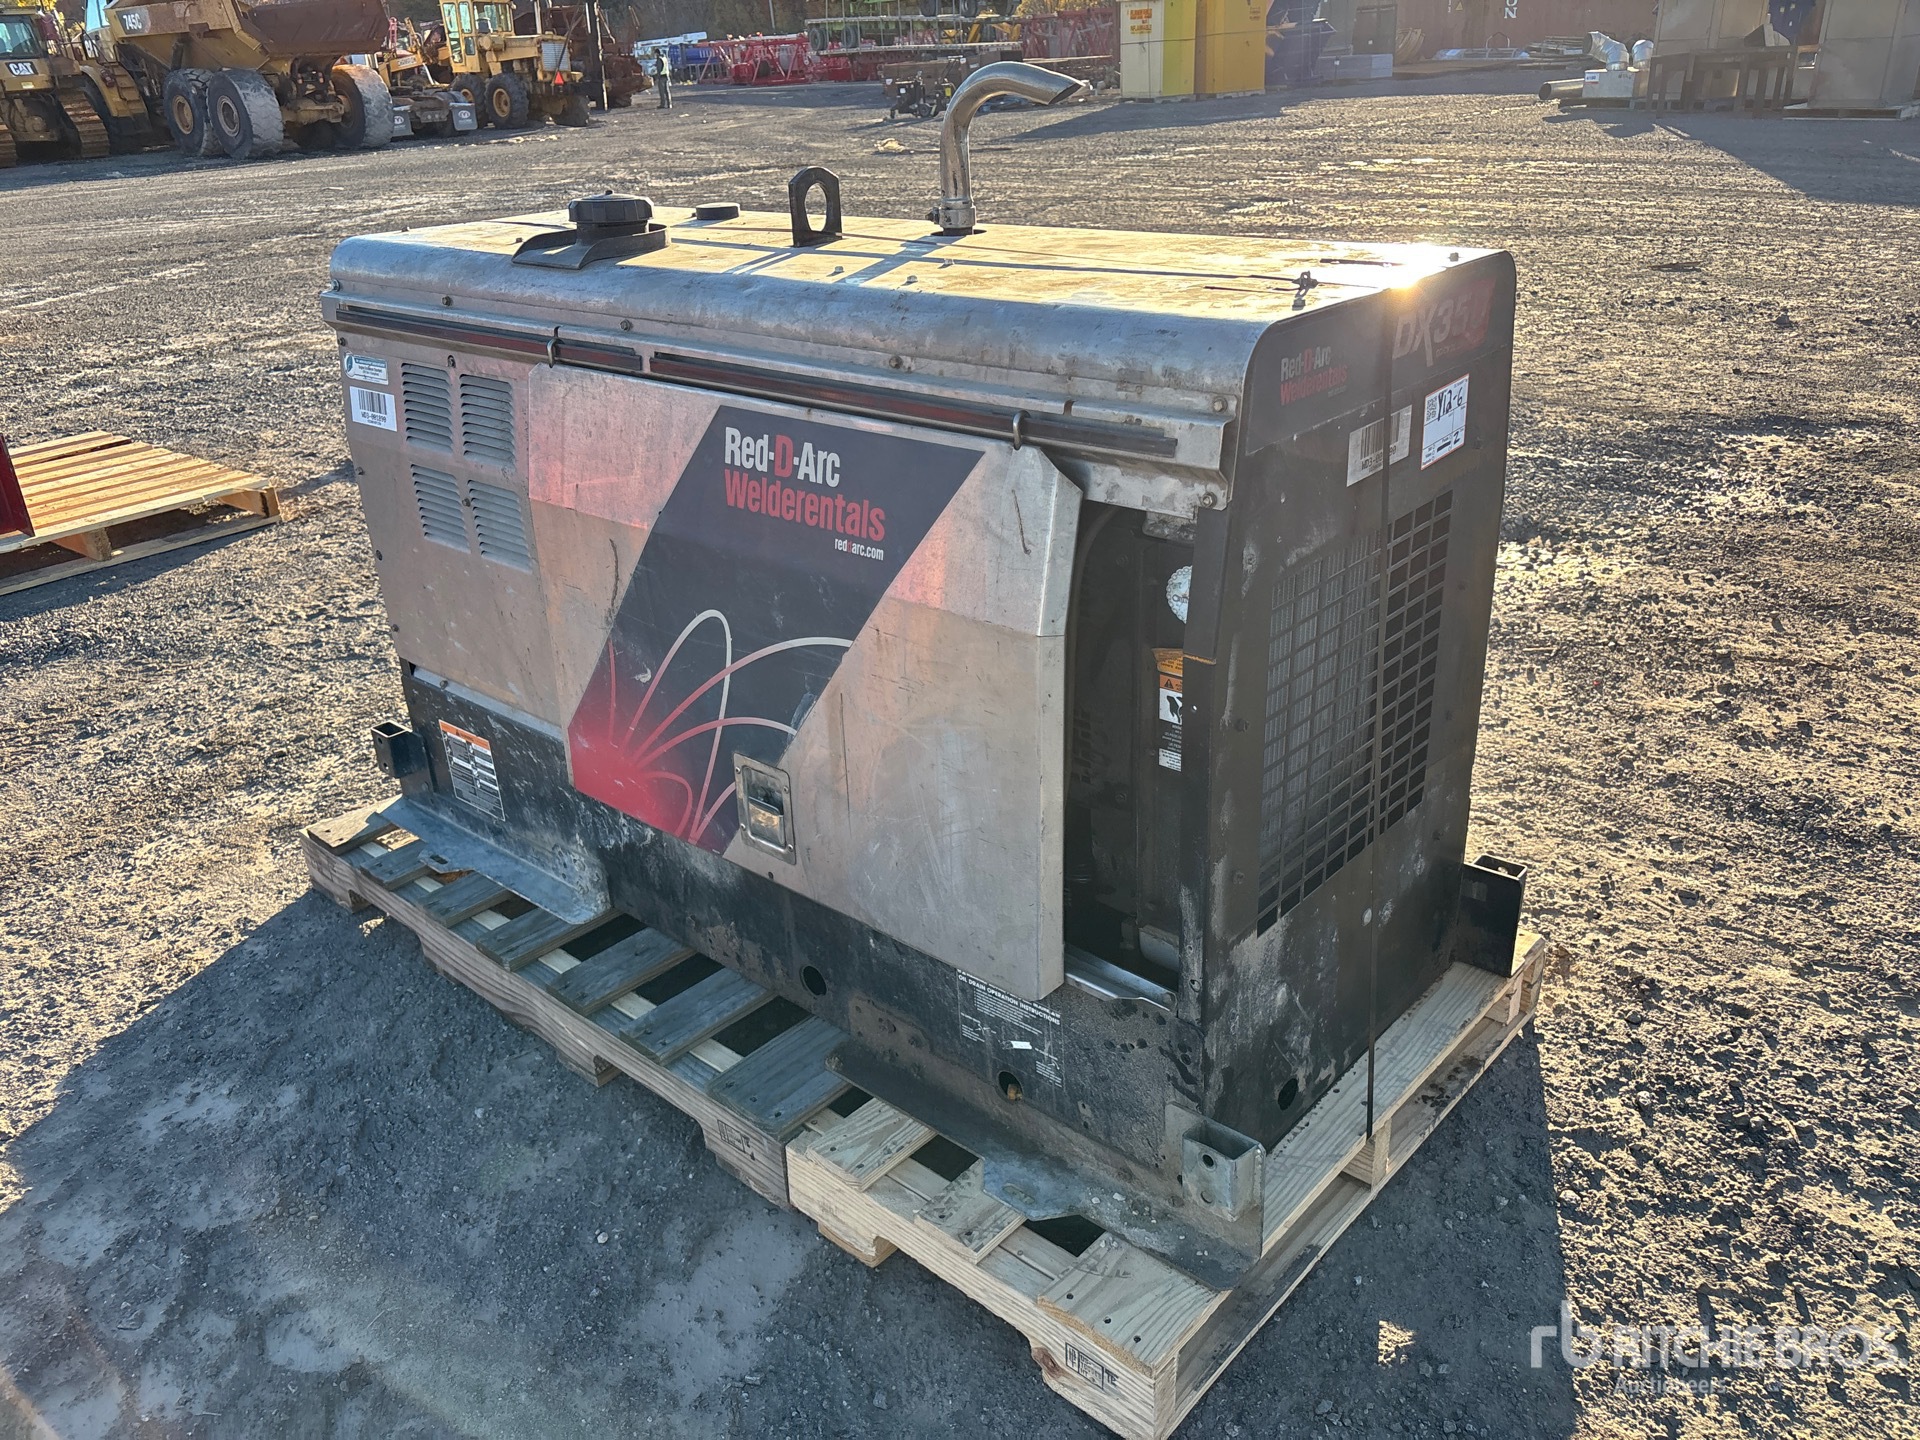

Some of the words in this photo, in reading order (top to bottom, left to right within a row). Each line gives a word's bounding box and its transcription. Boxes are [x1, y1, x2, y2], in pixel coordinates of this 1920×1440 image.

[122, 13, 142, 31] 745C
[9, 62, 35, 76] CAT
[1280, 346, 1331, 382] Red-D-Arc
[1280, 364, 1349, 406] Welderentals
[1453, 431, 1460, 445] 2
[725, 426, 841, 488] Red-D-Arc
[724, 468, 886, 542] Welderentals
[834, 538, 884, 561] reddarc.com
[958, 974, 968, 983] OIL
[968, 978, 986, 992] DRAIN
[986, 987, 1019, 1007] OPERATION
[1019, 1001, 1061, 1026] INSTRUCTIONS
